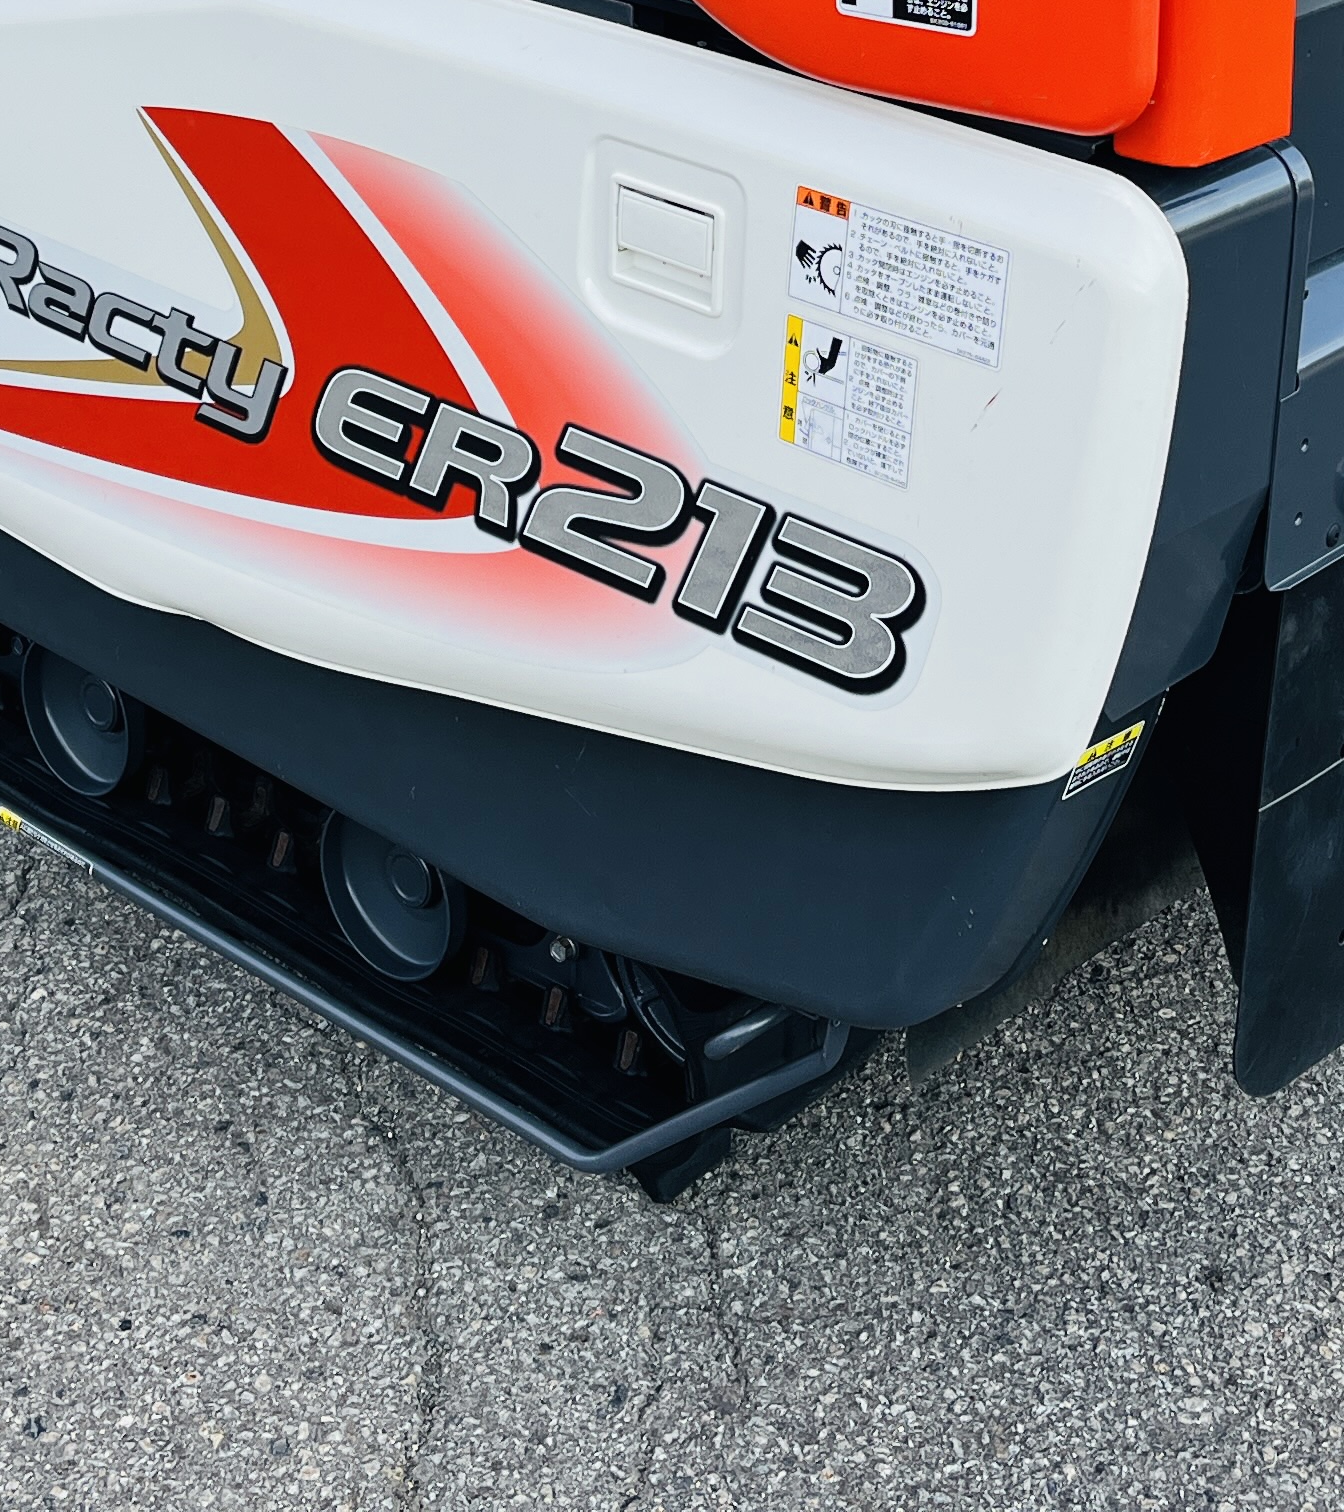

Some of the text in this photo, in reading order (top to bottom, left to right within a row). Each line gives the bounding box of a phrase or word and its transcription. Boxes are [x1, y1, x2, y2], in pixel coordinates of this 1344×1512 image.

[819, 195, 847, 217] 警告
[782, 370, 797, 421] 注意
[313, 364, 926, 696] ER213
